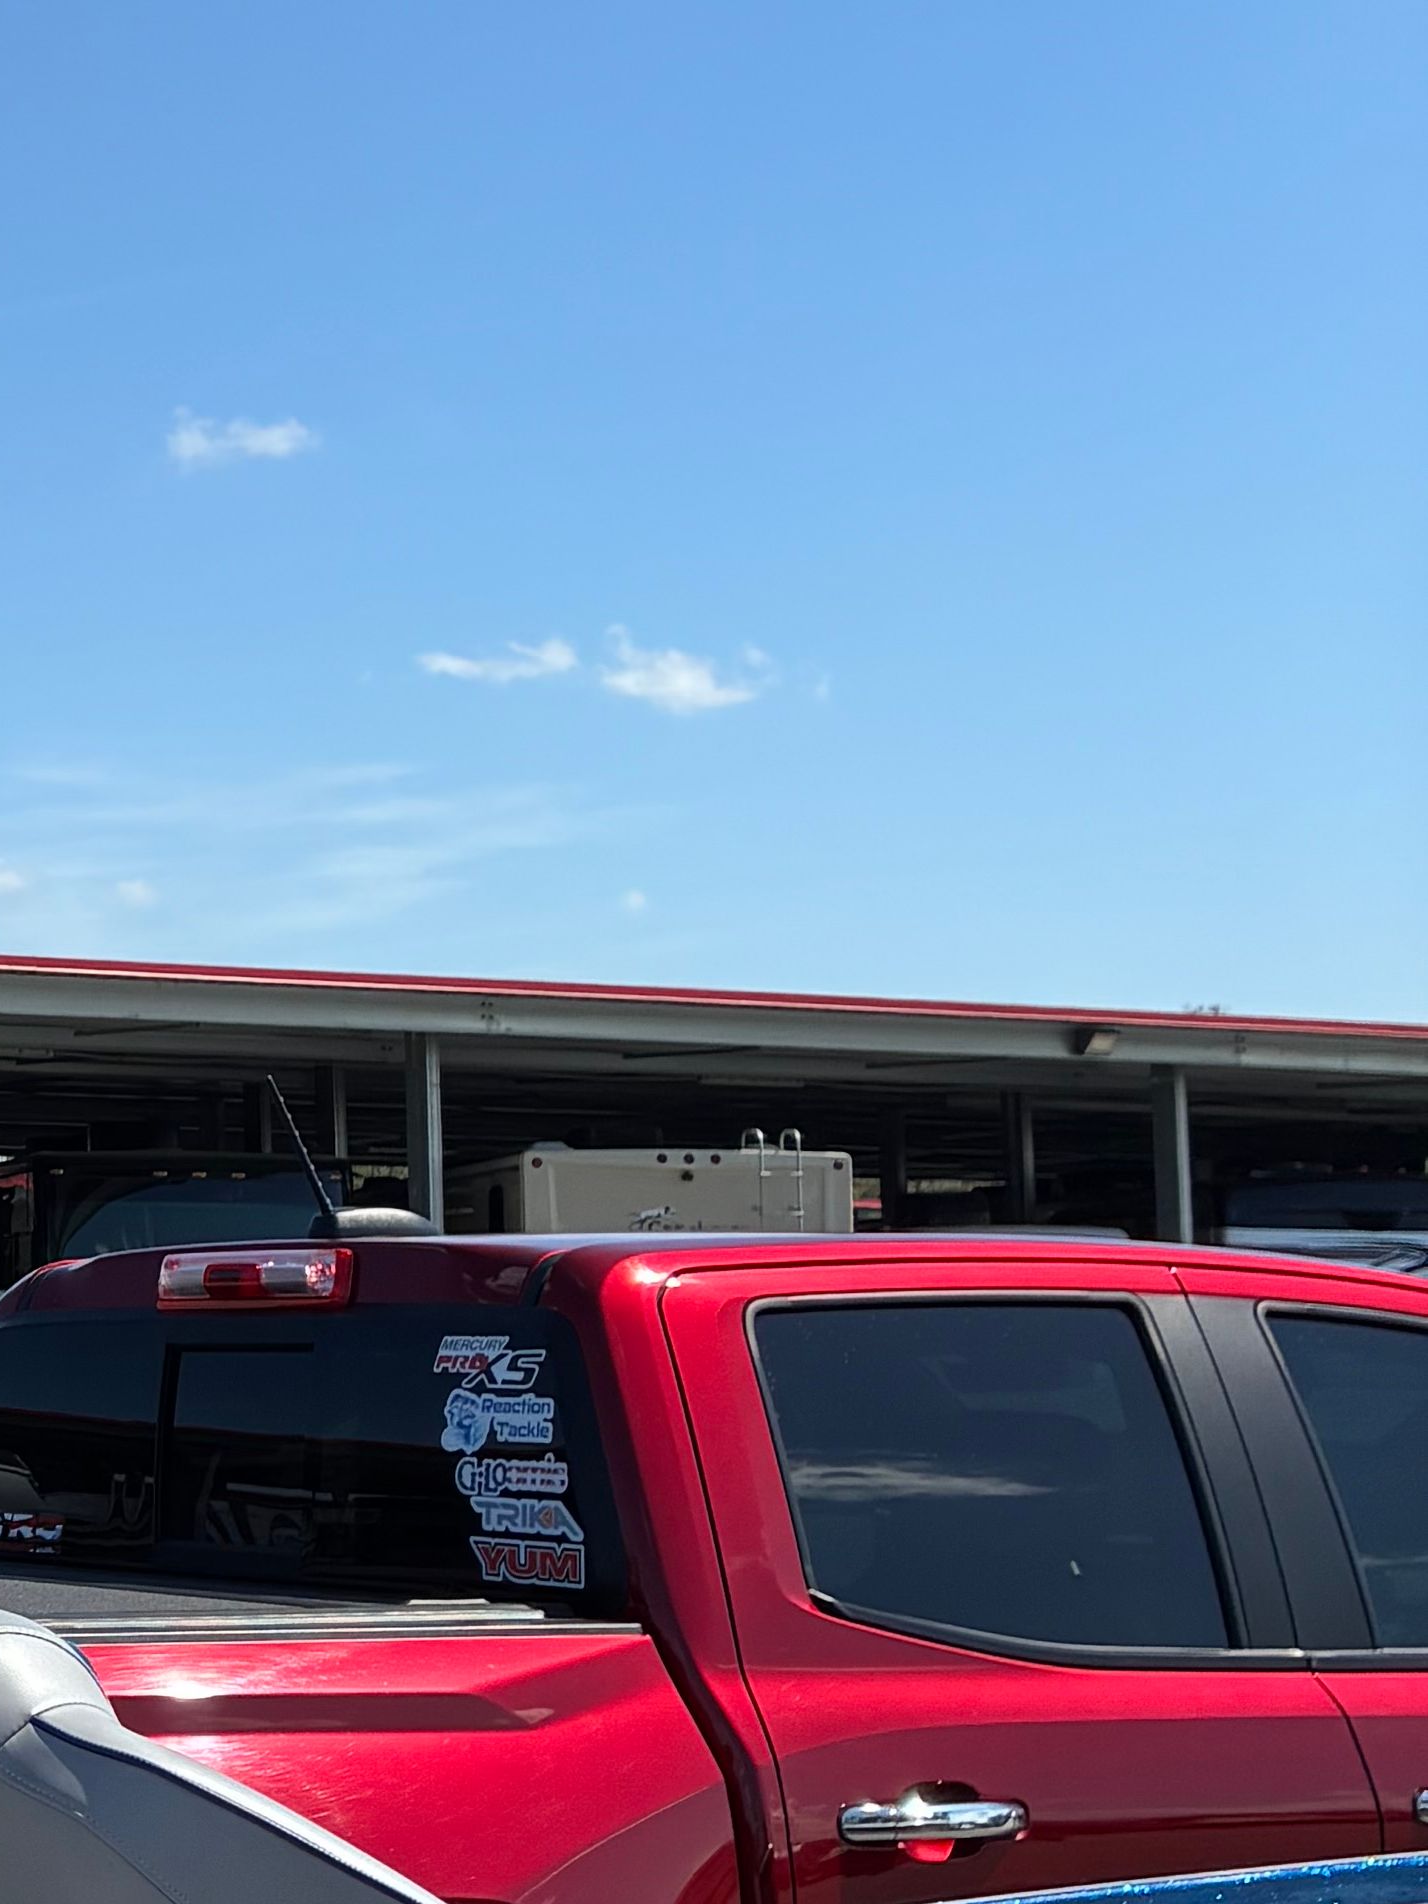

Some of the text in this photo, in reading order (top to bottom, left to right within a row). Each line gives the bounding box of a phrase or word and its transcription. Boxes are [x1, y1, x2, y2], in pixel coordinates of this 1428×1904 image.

[441, 1338, 508, 1351] MERCURY
[481, 1398, 551, 1415] Reaction
[496, 1421, 550, 1439] Tackle
[474, 1499, 580, 1538] TRIKA
[476, 1543, 580, 1582] YUM
